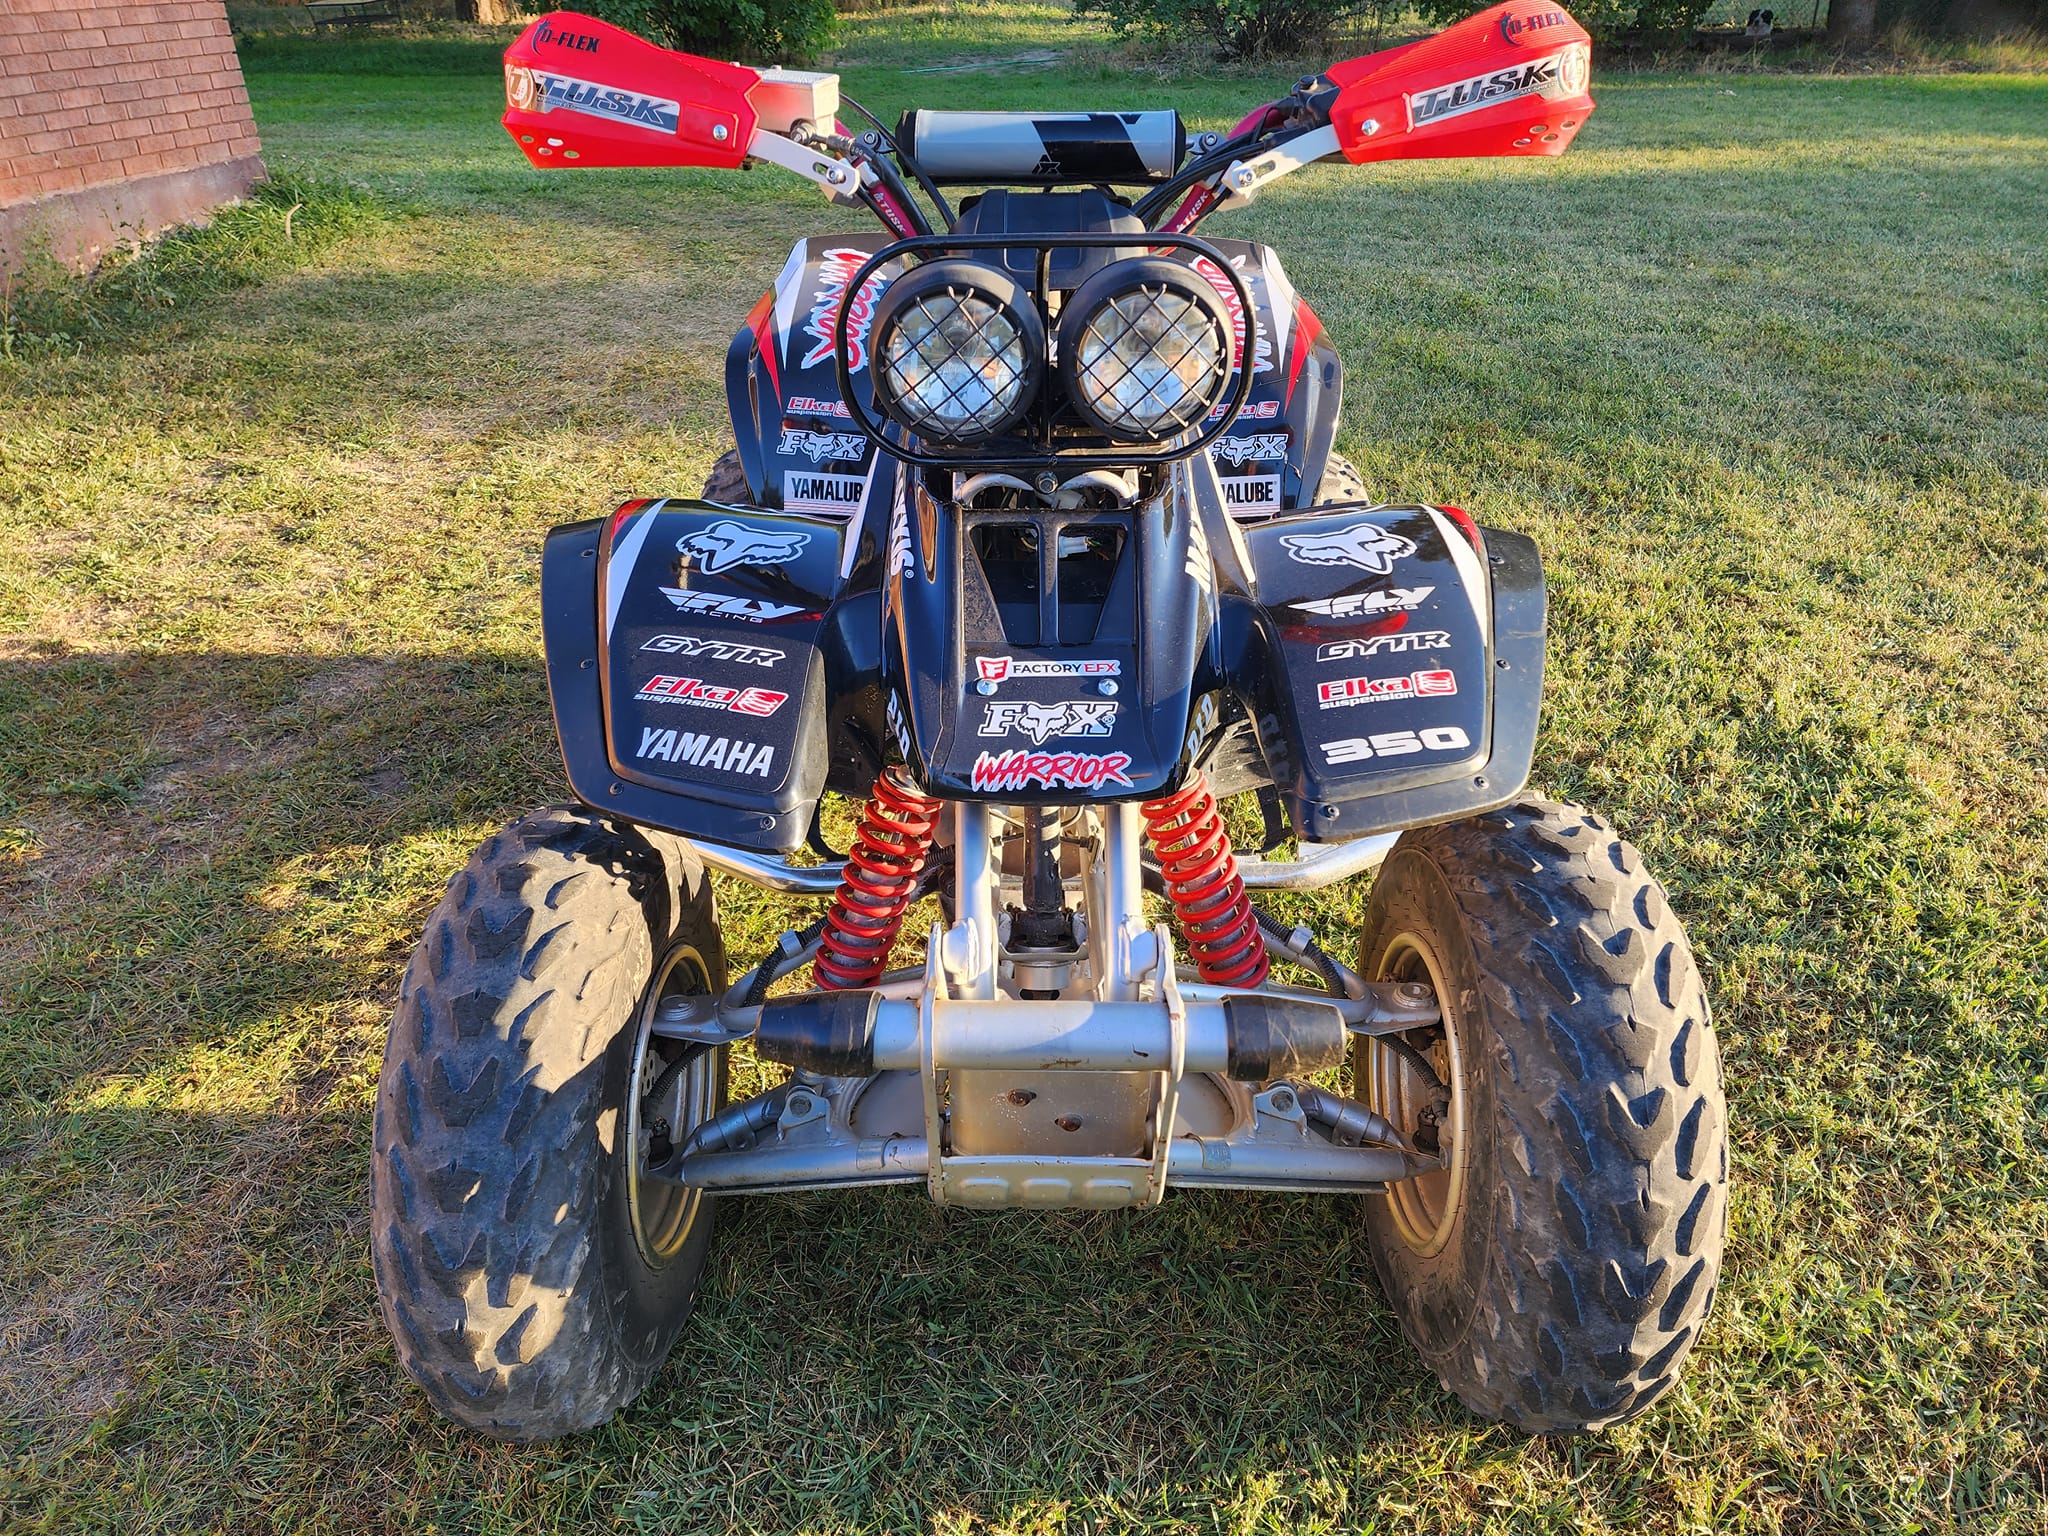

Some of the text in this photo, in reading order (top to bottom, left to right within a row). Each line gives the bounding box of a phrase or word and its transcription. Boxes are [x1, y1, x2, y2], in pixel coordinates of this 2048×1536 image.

[537, 75, 667, 125] TUSK
[1419, 61, 1552, 118] TUSK
[881, 202, 906, 233] TUSK
[788, 397, 834, 411] Elka
[791, 477, 863, 502] YAMALUB
[1222, 481, 1274, 504] ALUBE
[658, 587, 806, 619] FLY
[676, 606, 764, 624] RACING
[1288, 586, 1436, 615] FLY
[1331, 604, 1419, 619] RACING
[639, 634, 787, 667] GYTR
[1316, 631, 1452, 662] GYTR
[1013, 663, 1082, 674] FACTORY
[633, 693, 727, 710] suspension
[640, 674, 739, 702] Elka
[1317, 676, 1413, 702] Elka
[1319, 691, 1415, 710] suspension
[977, 701, 1119, 745] FOX
[635, 727, 775, 778] YAMAHA
[1320, 727, 1471, 765] 350
[971, 750, 1134, 792] WARRIOR
